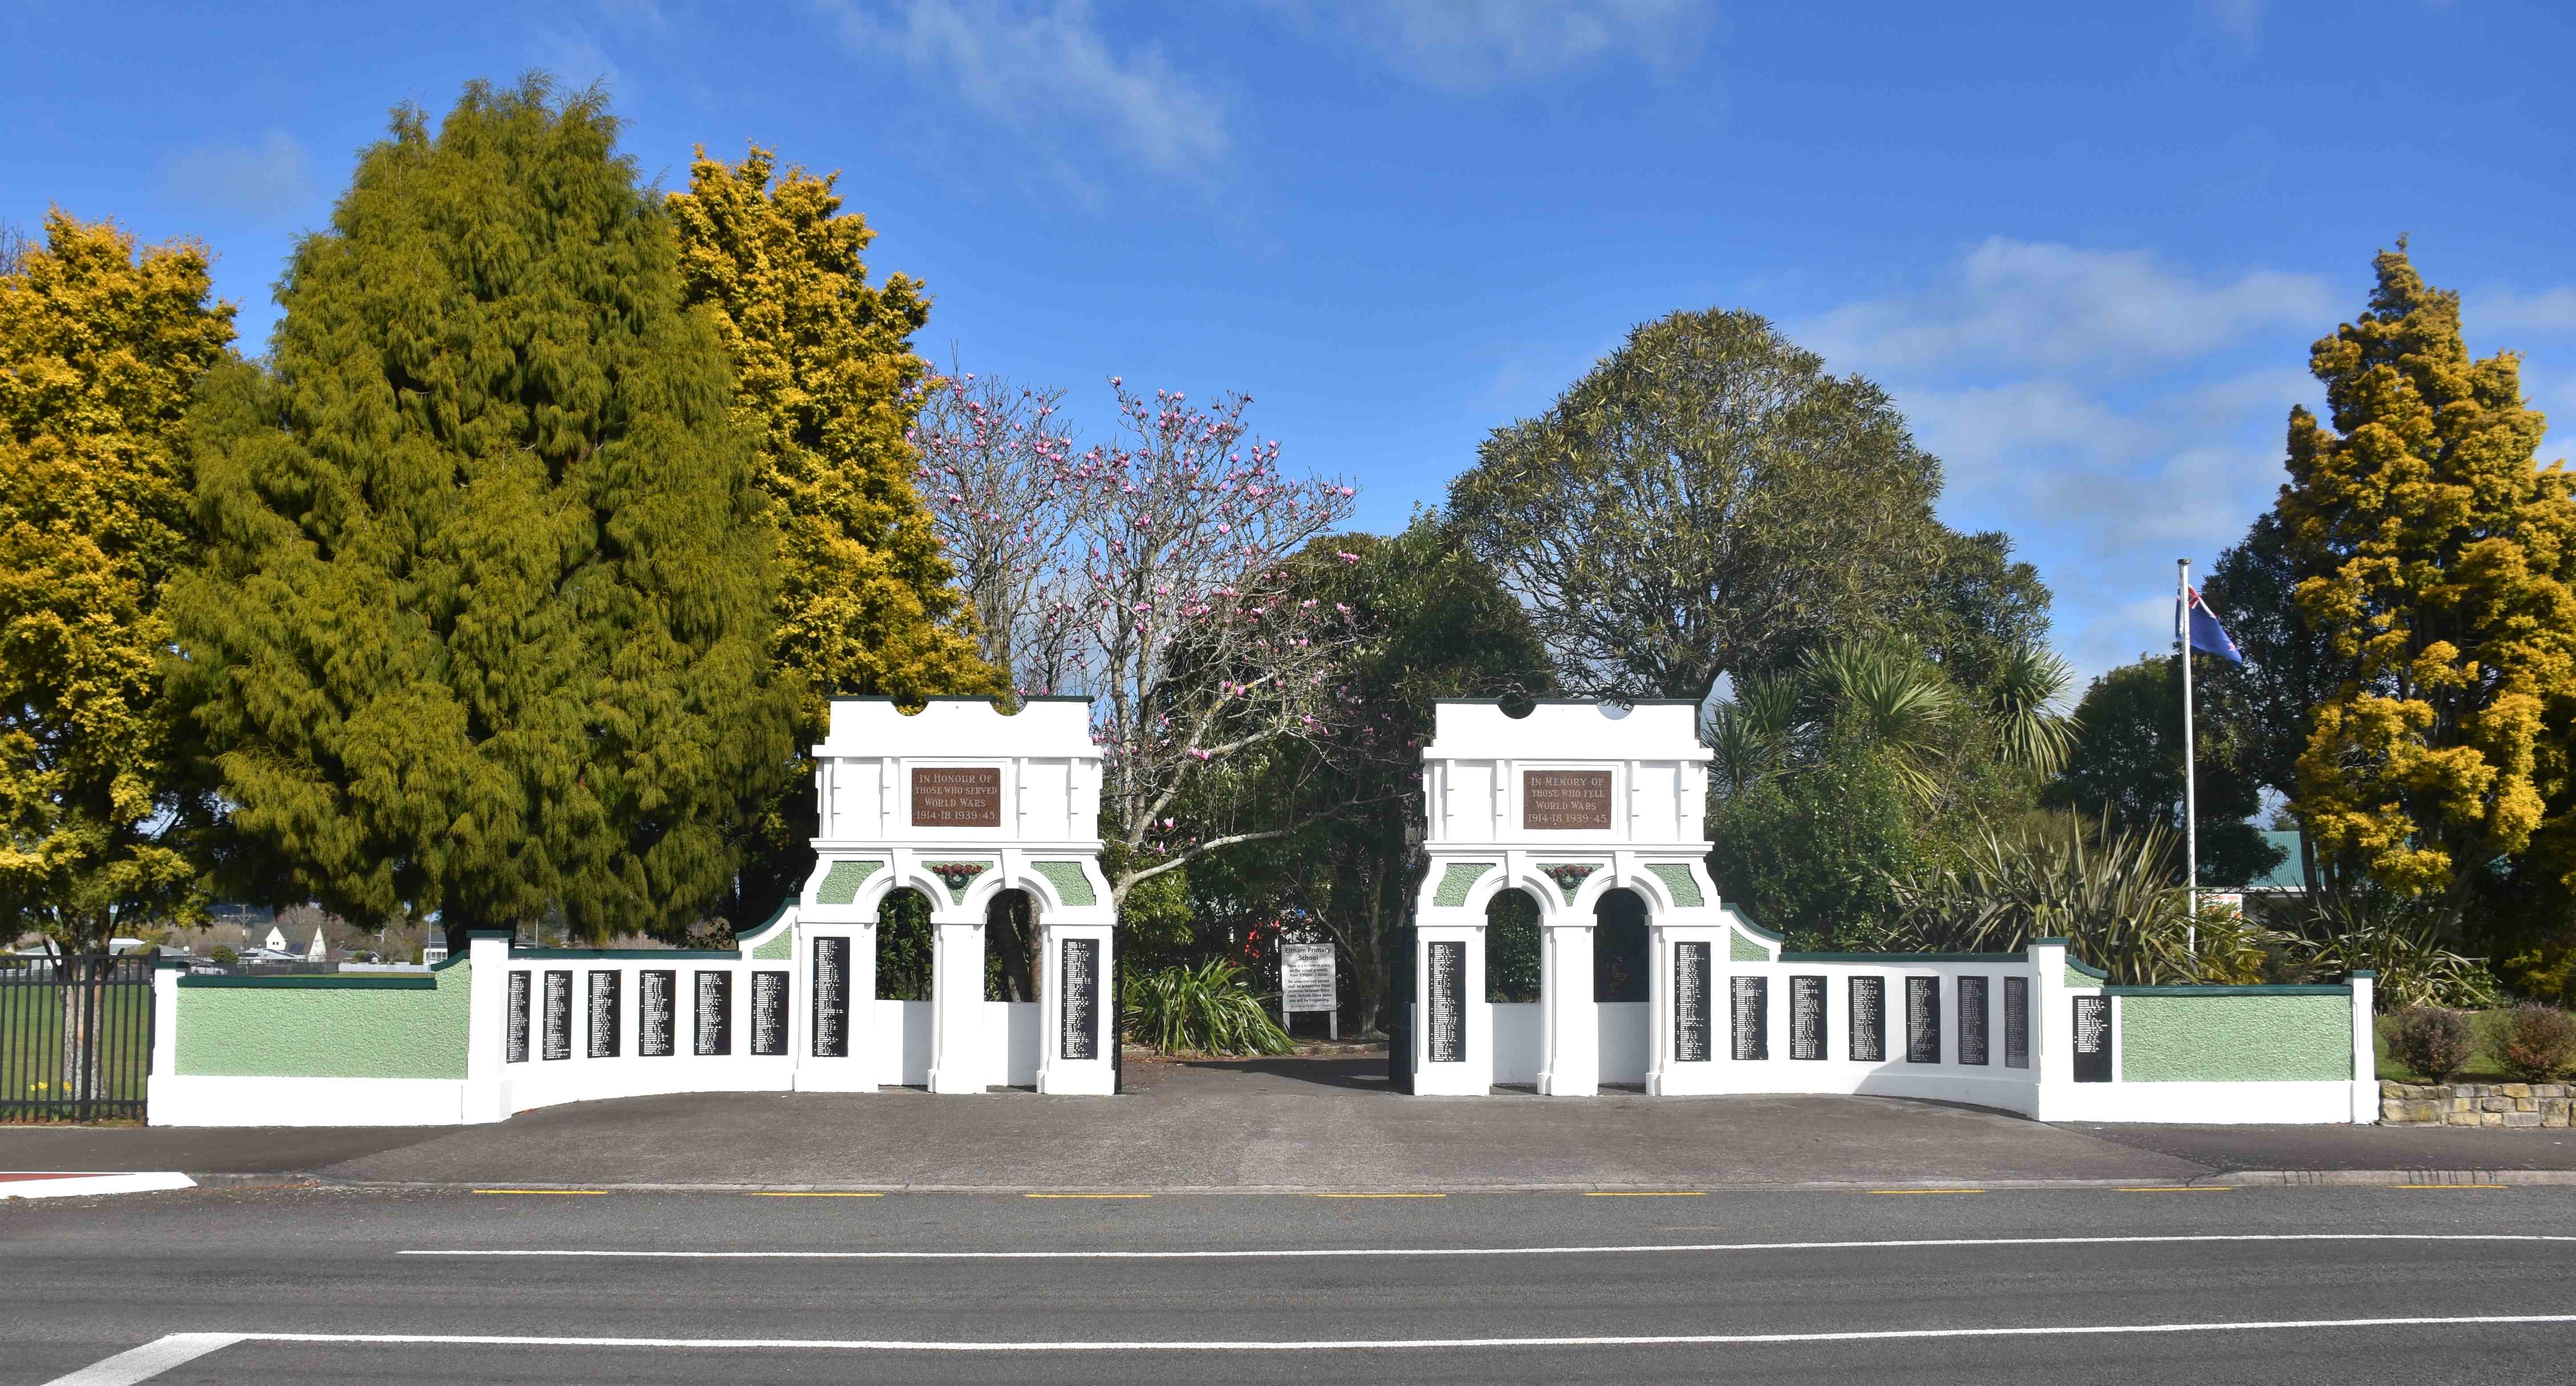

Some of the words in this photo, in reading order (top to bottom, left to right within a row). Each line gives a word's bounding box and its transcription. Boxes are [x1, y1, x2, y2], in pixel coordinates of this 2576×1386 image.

[919, 774, 930, 783] IN
[935, 774, 975, 783] HONOUR
[979, 774, 992, 783] OF
[1531, 777, 1541, 786] IN
[1546, 777, 1587, 786] MEMORY
[1591, 777, 1604, 786] OF
[925, 798, 956, 807] WORLD
[960, 798, 986, 807] WARS
[1536, 801, 1568, 810] WORLD
[1571, 801, 1597, 810] WARS
